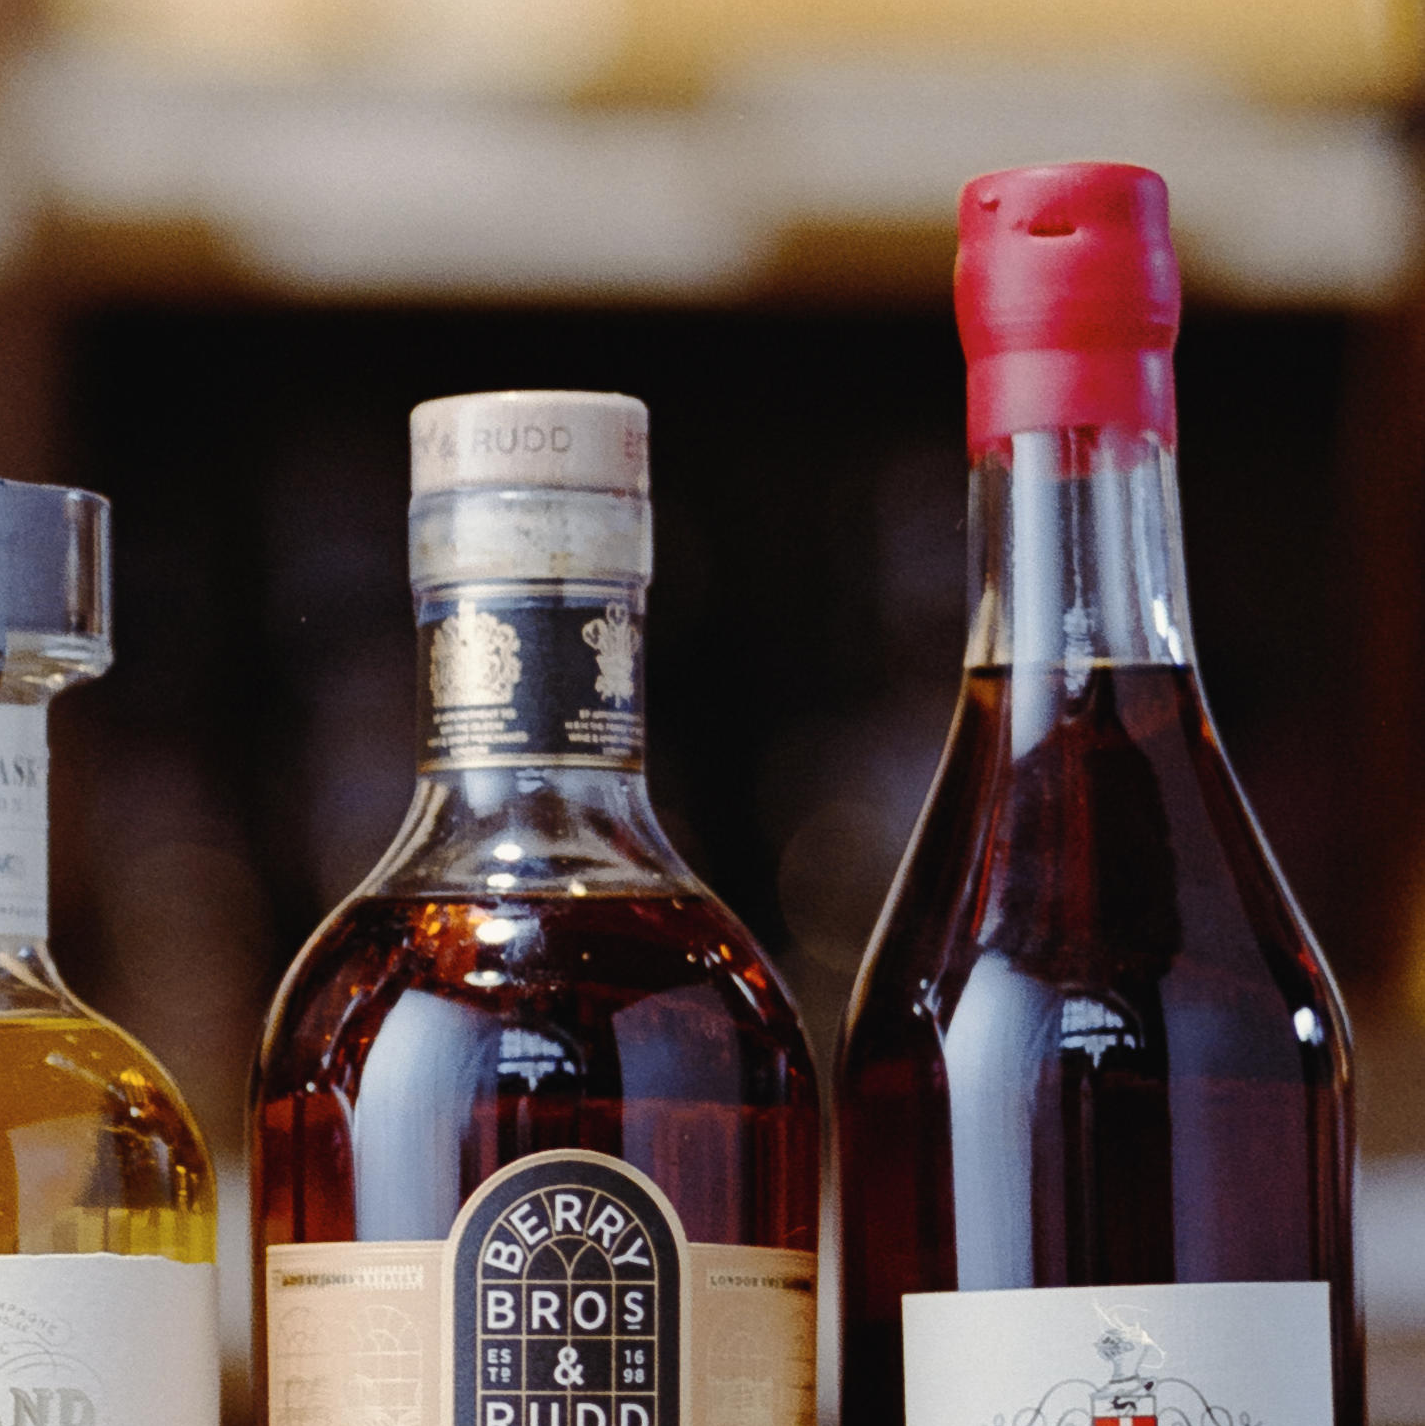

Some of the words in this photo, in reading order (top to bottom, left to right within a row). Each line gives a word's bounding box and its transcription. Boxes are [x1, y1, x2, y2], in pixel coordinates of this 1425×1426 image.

[471, 425, 574, 454] RUDD
[484, 1193, 650, 1274] BERRY
[486, 1289, 645, 1331] BROS
[553, 1345, 585, 1387] &
